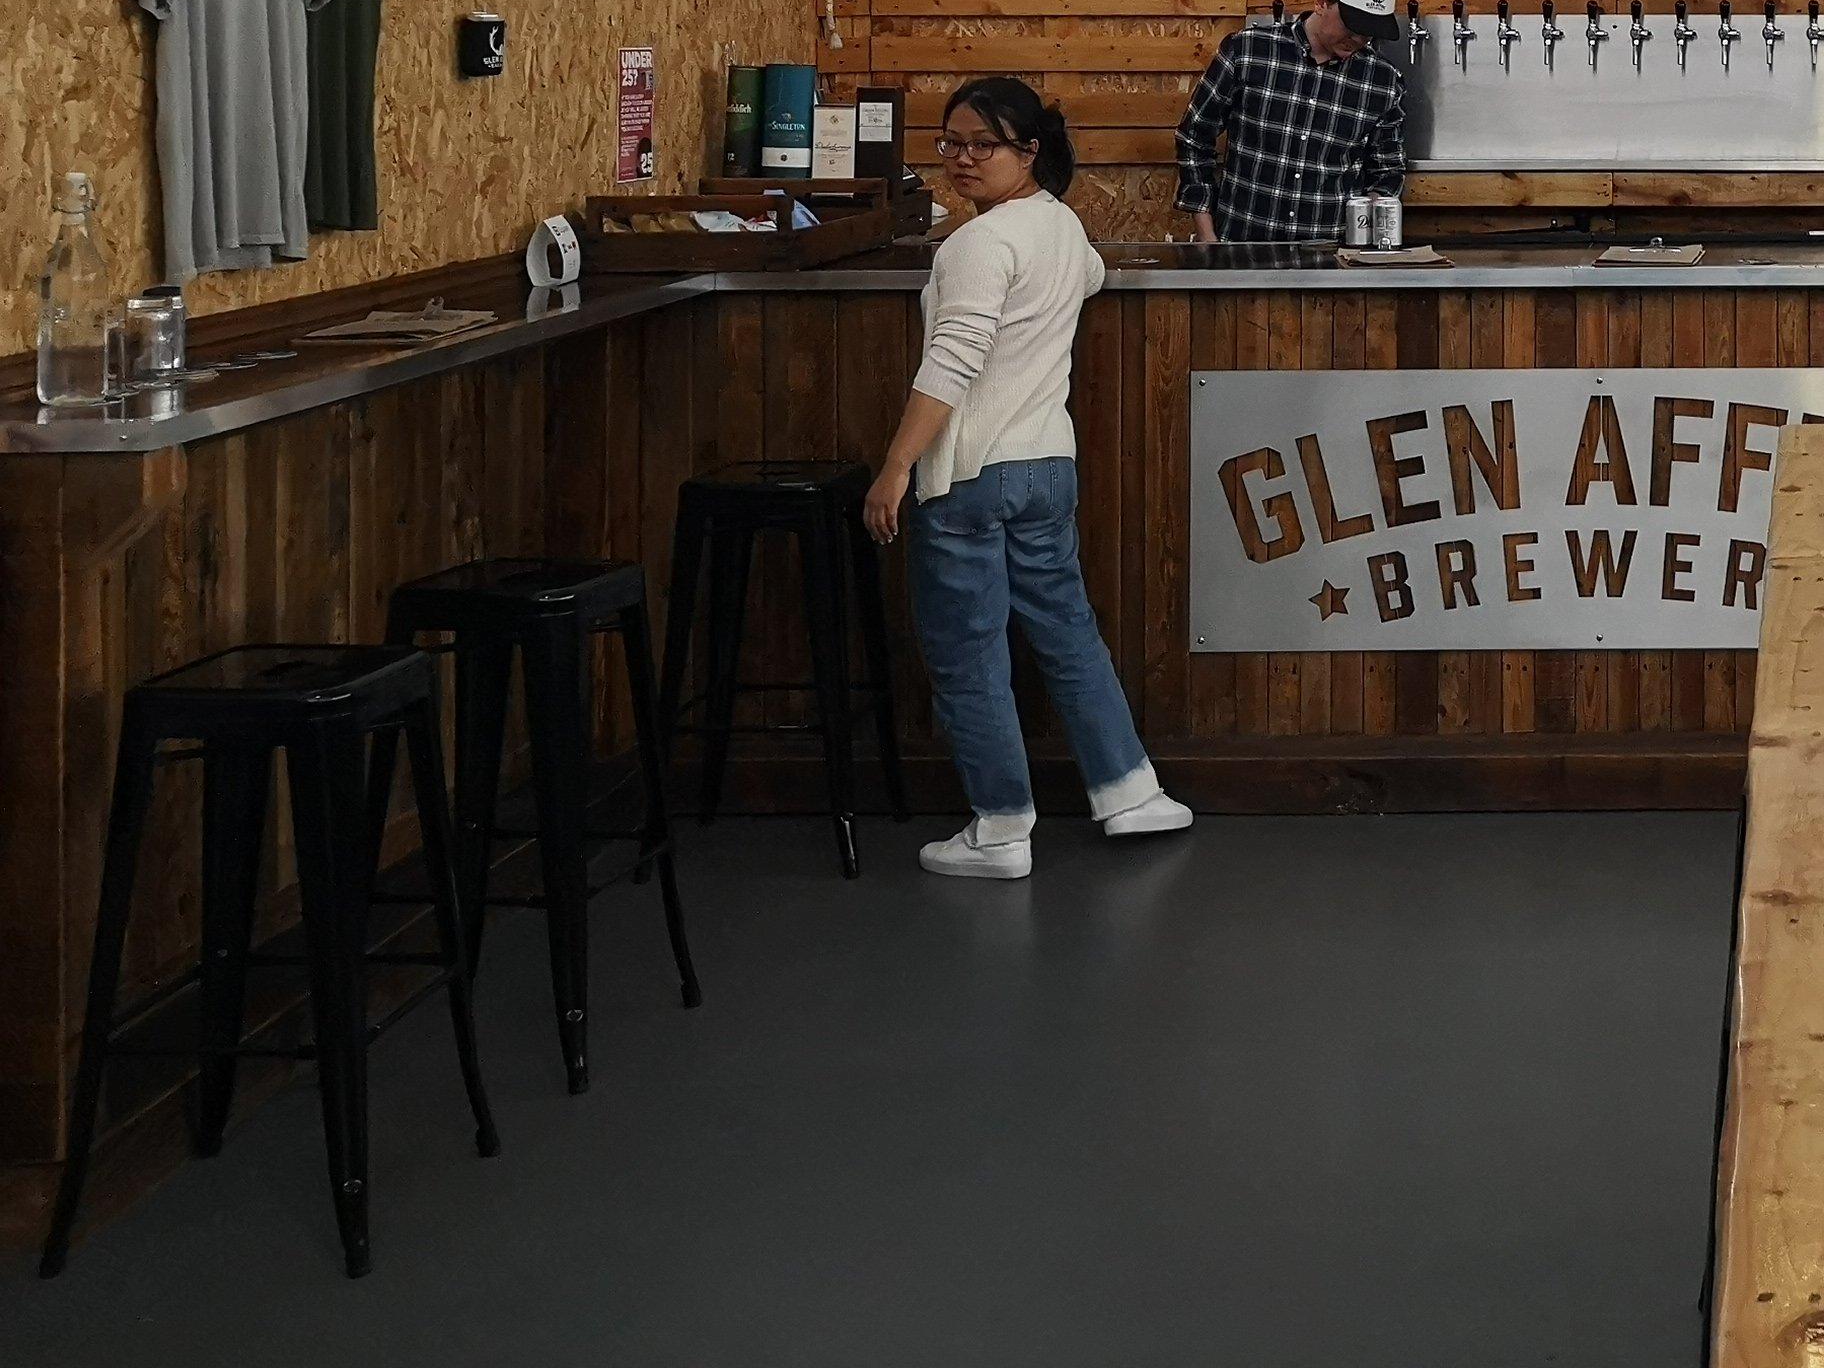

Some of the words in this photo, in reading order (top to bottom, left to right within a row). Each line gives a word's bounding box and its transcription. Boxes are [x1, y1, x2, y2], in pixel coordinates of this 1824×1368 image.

[621, 52, 652, 68] UNDER
[641, 153, 652, 173] 25
[1217, 400, 1523, 563] GLEN
[1565, 395, 1797, 513] AFF
[1367, 529, 1766, 622] BREWER
